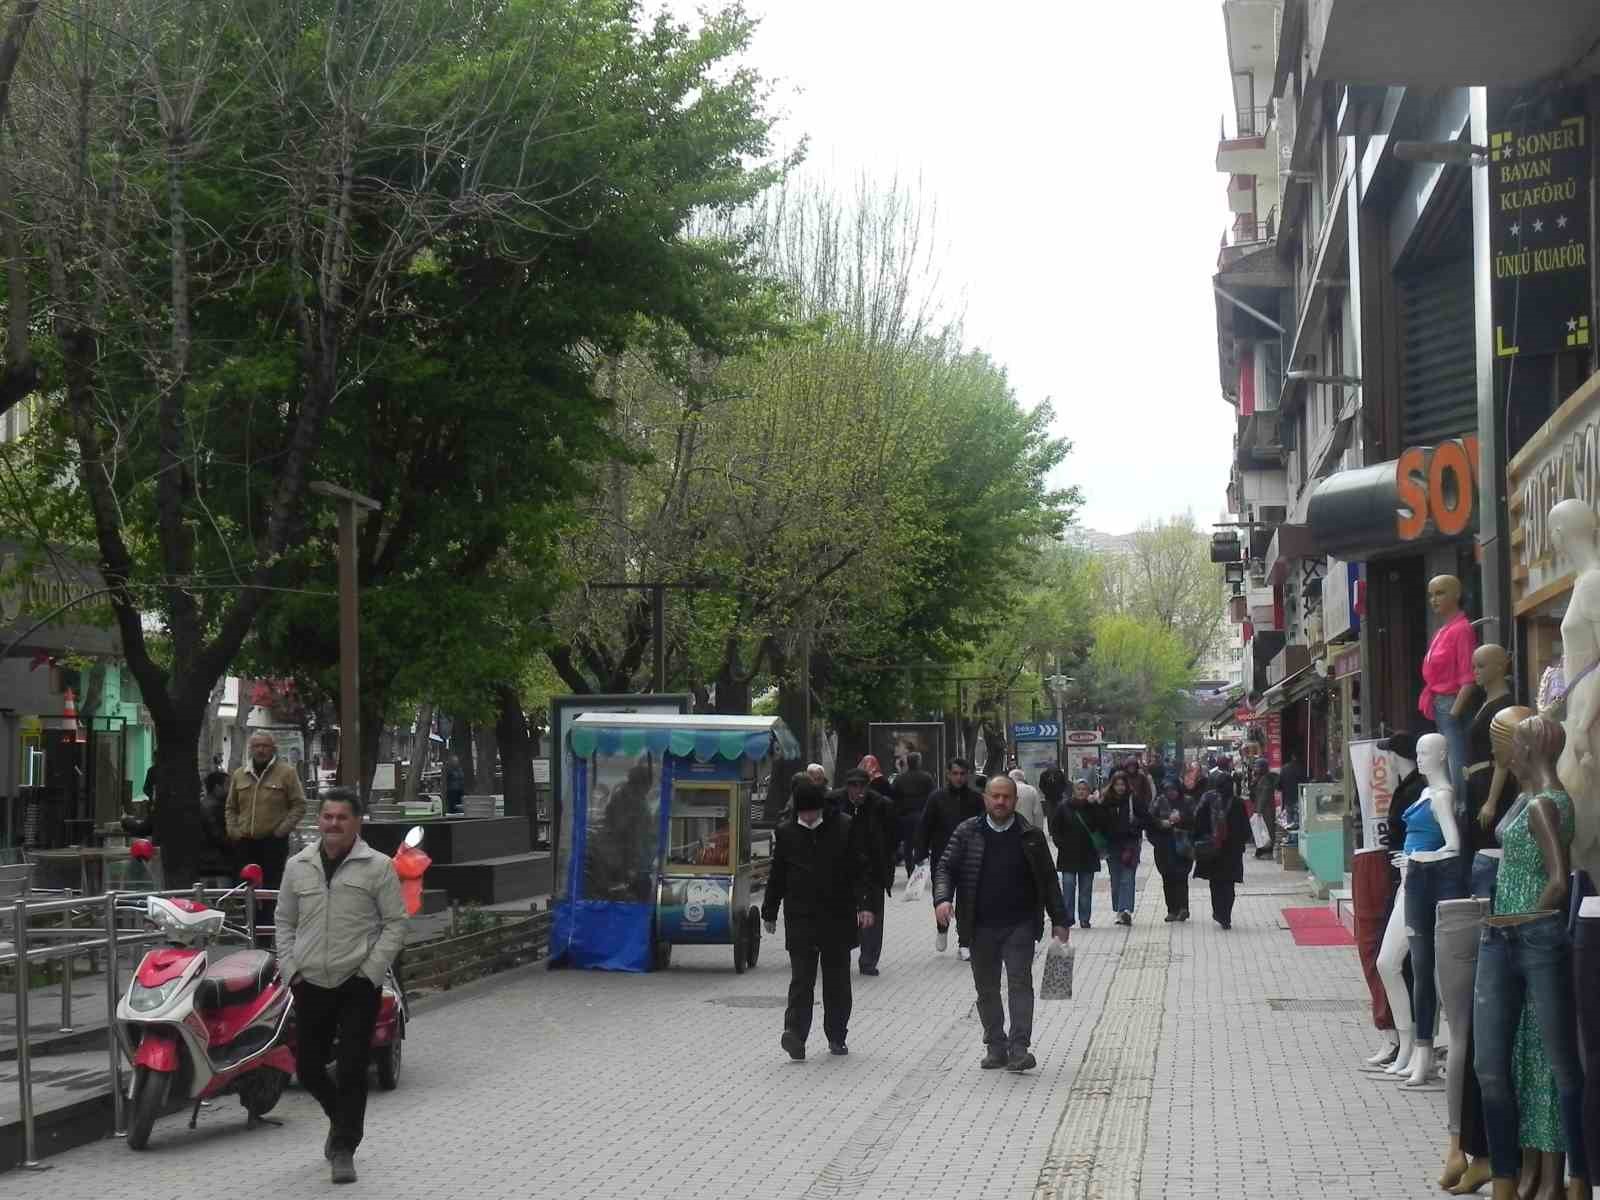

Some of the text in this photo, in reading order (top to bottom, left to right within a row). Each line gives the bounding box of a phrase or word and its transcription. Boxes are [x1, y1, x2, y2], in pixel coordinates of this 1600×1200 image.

[1517, 129, 1575, 157] SONER
[1501, 158, 1552, 184] BAYAN
[1501, 177, 1576, 211] KUAFÖRÜ
[1496, 240, 1586, 279] ÜNLÜ KUAFÖR
